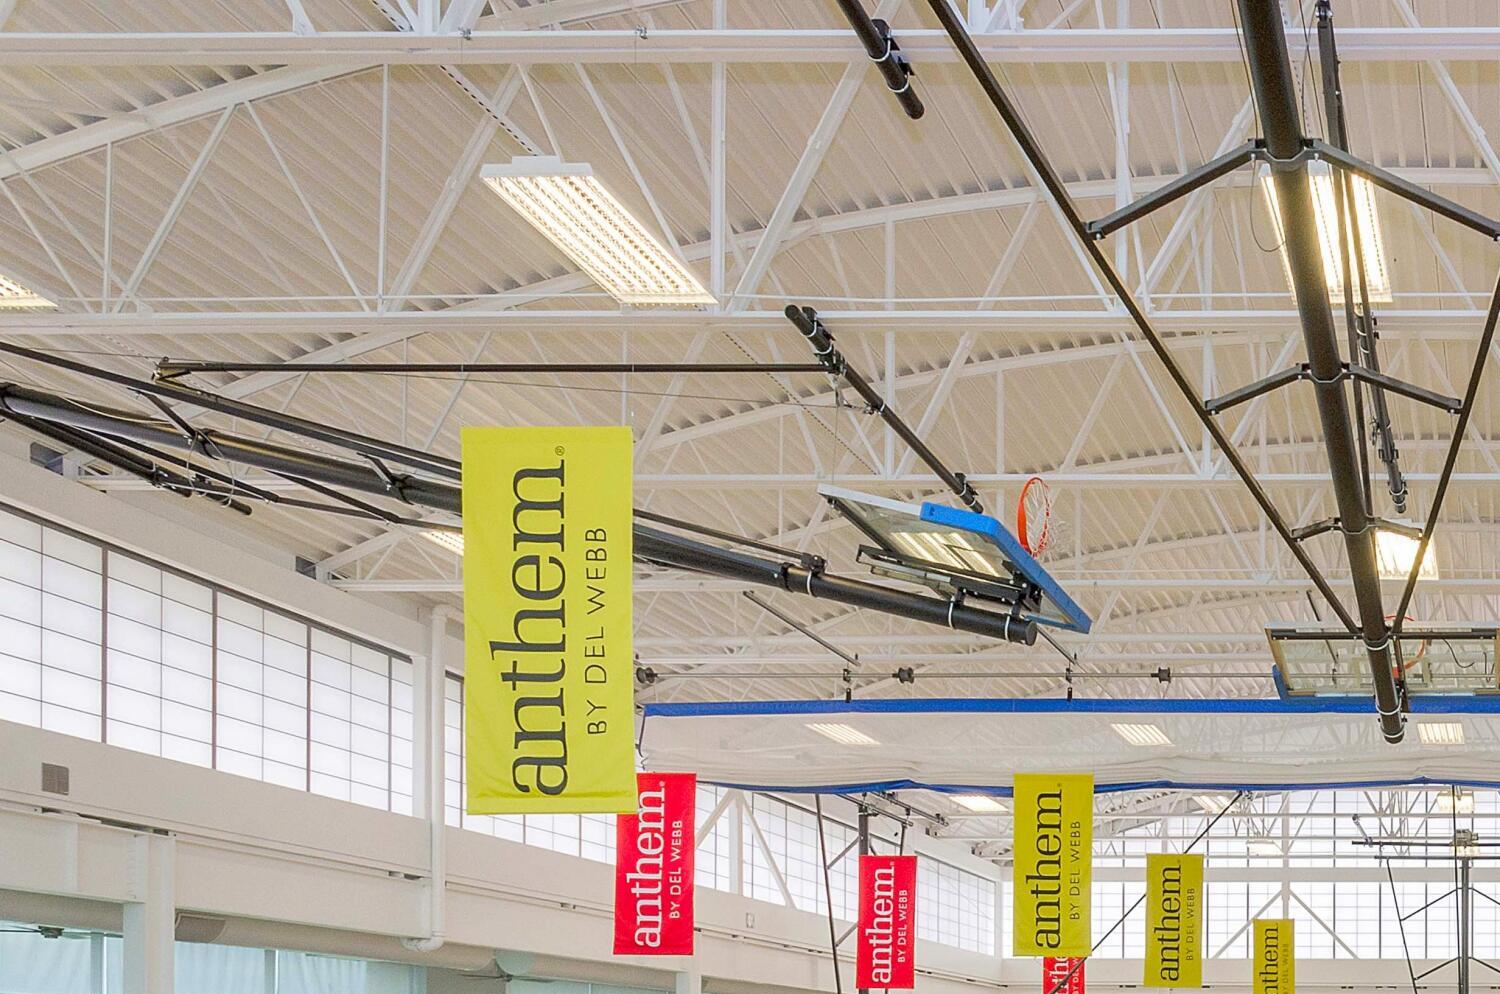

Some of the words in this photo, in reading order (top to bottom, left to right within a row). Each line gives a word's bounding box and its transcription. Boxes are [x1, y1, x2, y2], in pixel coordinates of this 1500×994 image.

[585, 528, 607, 615] WEBB
[585, 626, 607, 684] DEL
[586, 699, 607, 734] BY
[670, 820, 682, 862] WEBB
[1070, 821, 1081, 862] WEBB
[669, 867, 682, 896] DEL
[1069, 869, 1080, 896] DEL
[669, 901, 681, 919] BY
[898, 889, 908, 921] WEBB
[1070, 903, 1080, 920] BY
[1187, 888, 1195, 919] WEBB
[898, 925, 907, 945] DEL
[1186, 923, 1194, 944] DEL
[897, 949, 906, 963] BY
[1186, 947, 1193, 961] BY
